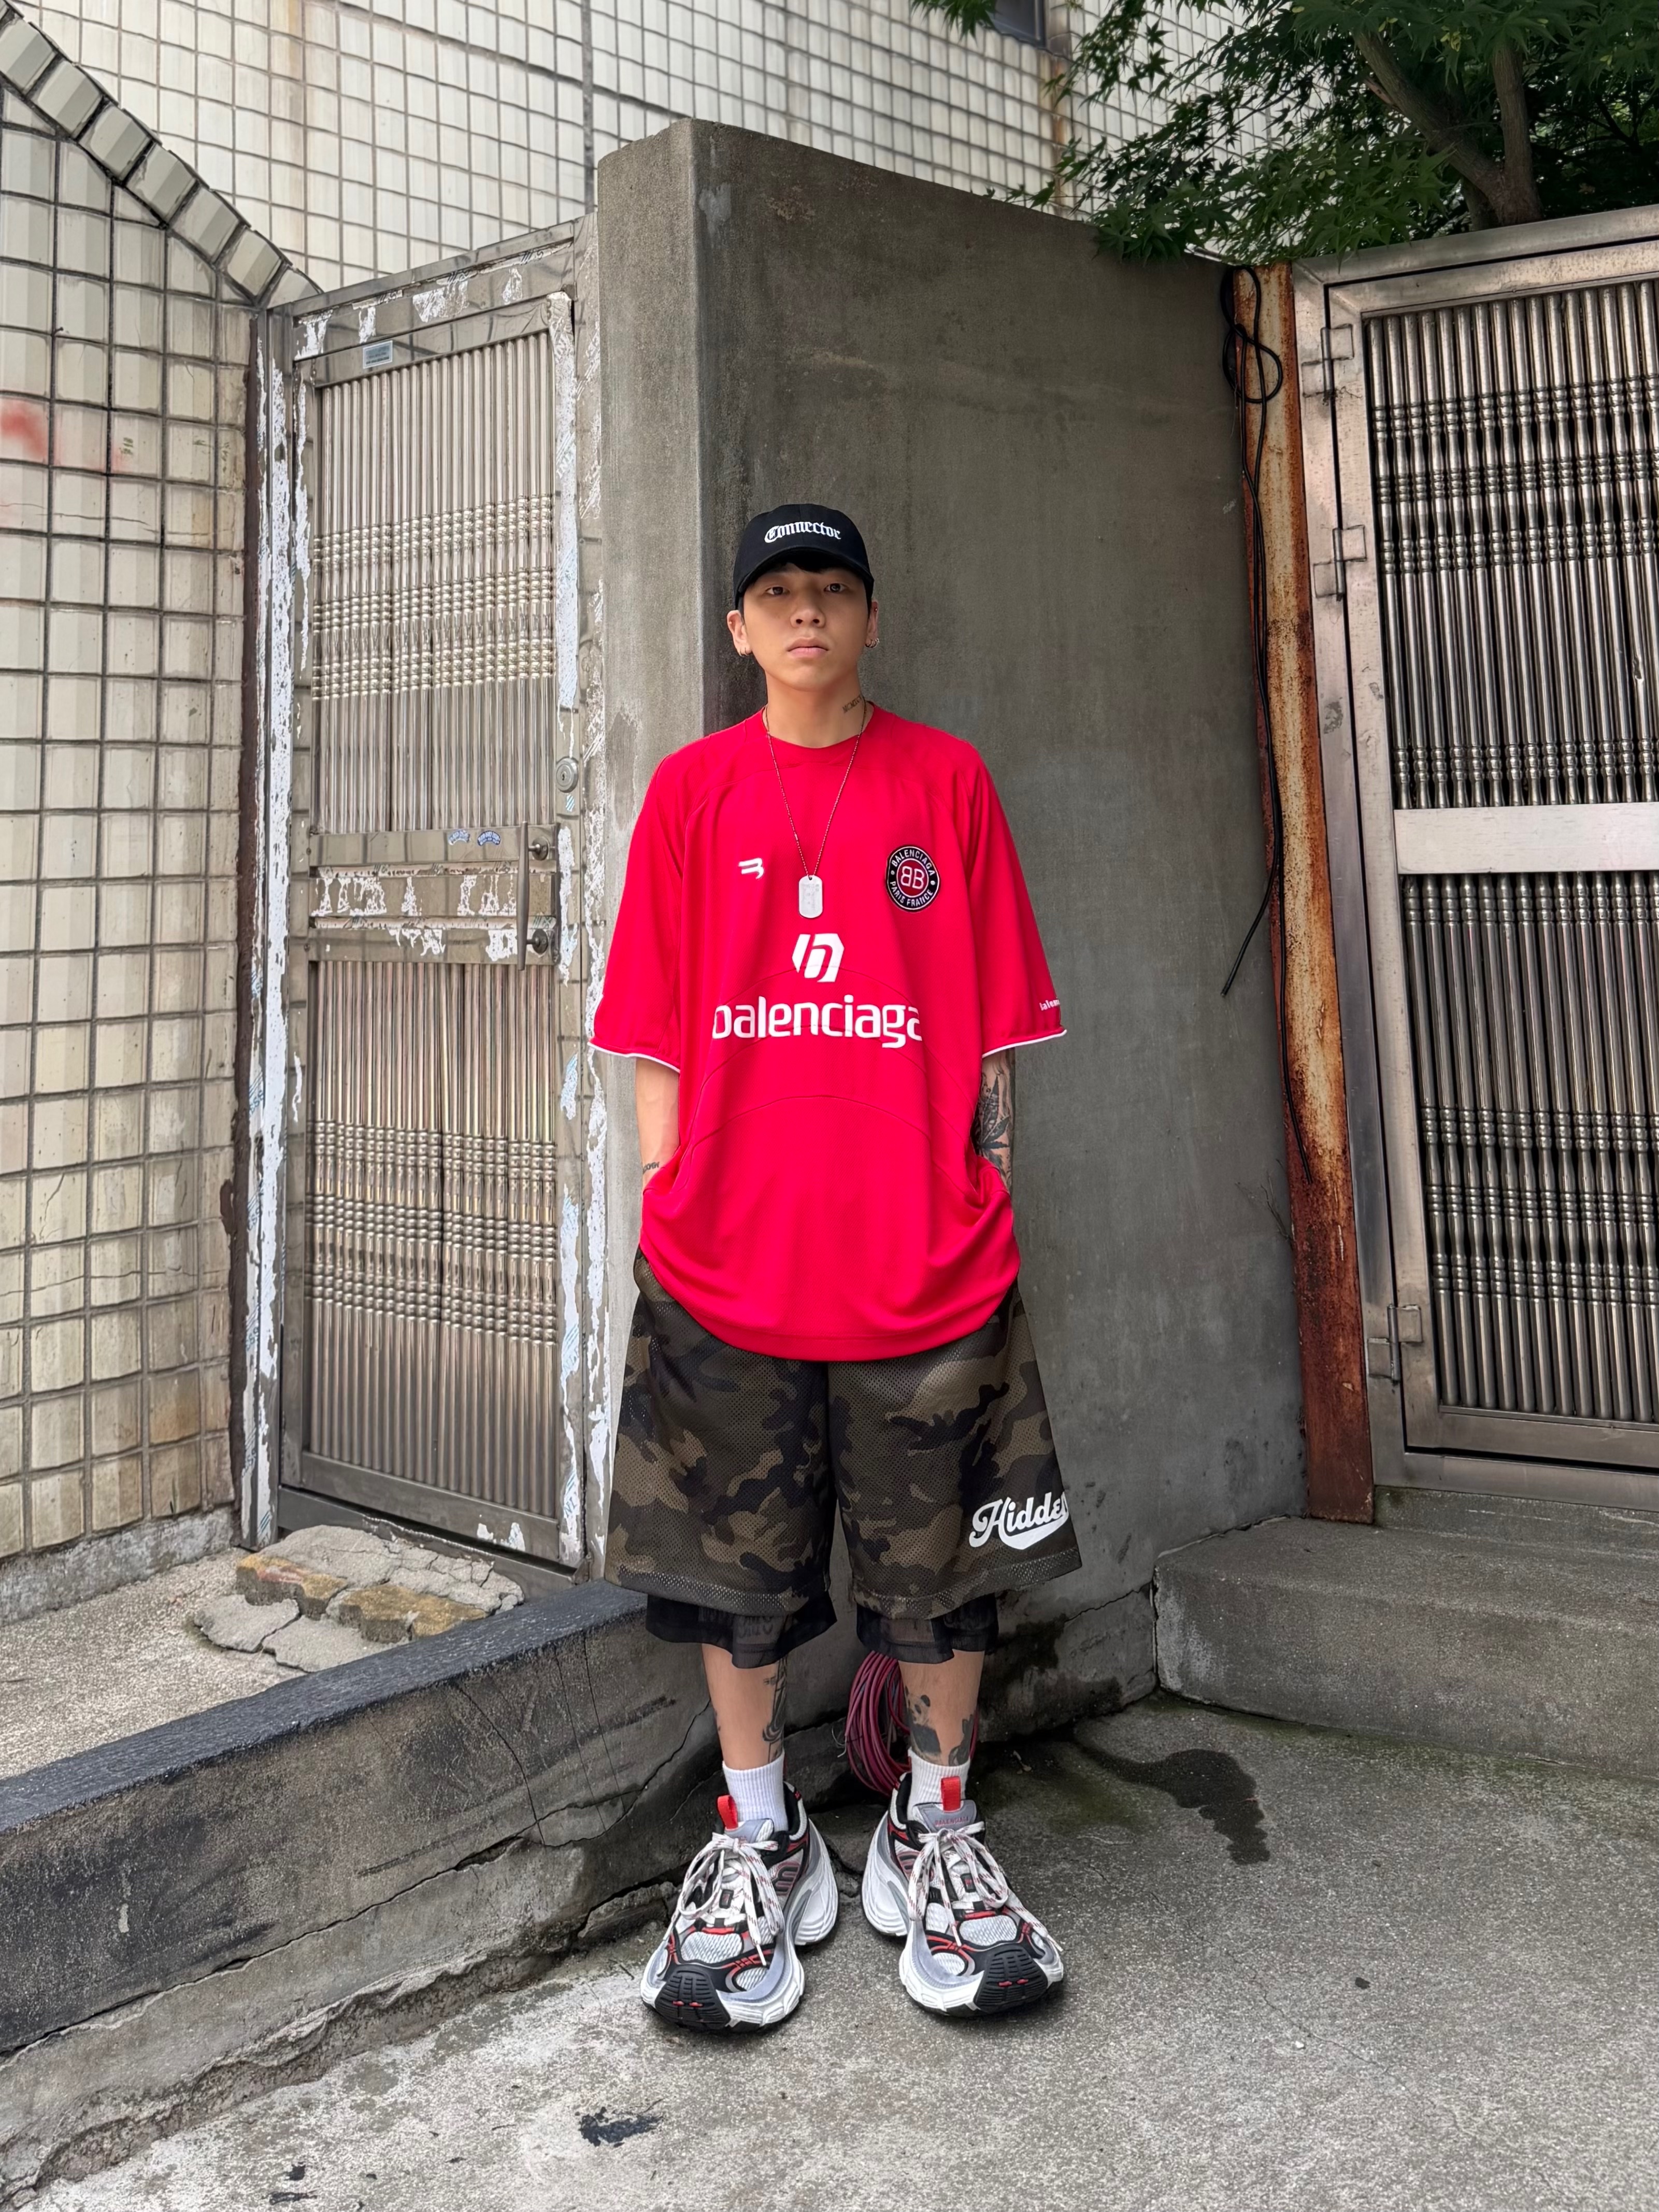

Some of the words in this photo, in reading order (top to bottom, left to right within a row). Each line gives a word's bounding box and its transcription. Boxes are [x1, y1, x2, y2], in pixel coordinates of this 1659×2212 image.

[764, 521, 841, 543] Connector
[891, 849, 935, 876] BALENCIAGA
[890, 881, 906, 904] PARIS
[907, 889, 933, 907] FRANCE
